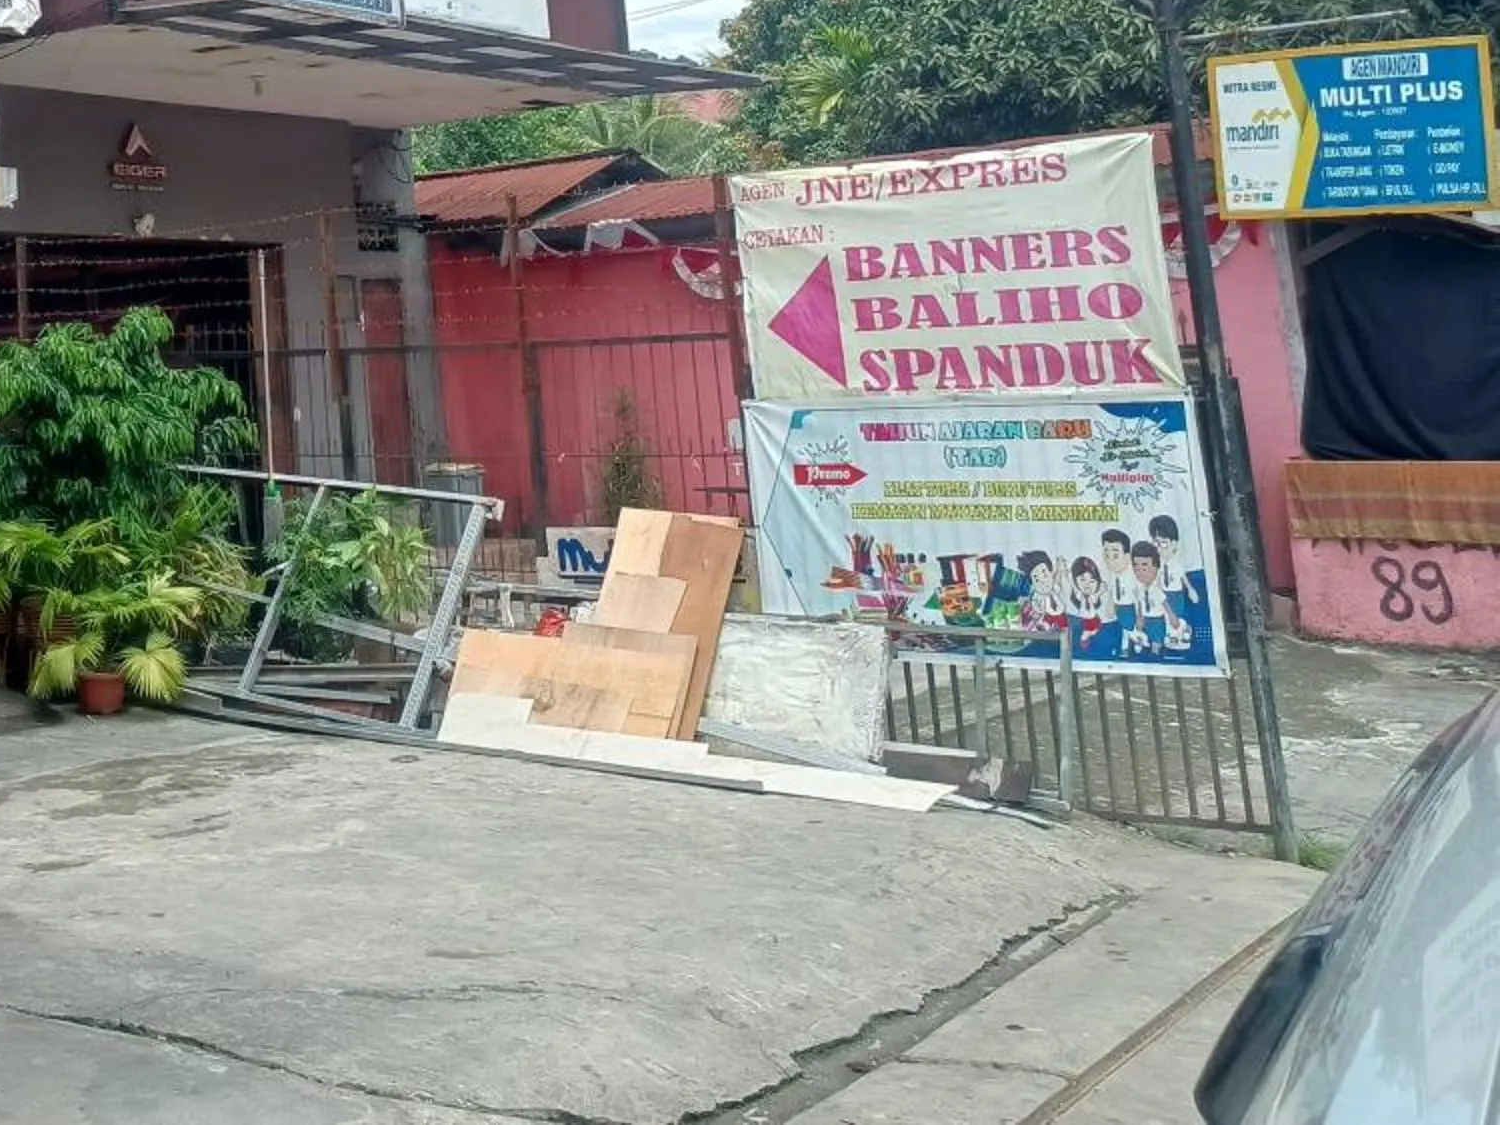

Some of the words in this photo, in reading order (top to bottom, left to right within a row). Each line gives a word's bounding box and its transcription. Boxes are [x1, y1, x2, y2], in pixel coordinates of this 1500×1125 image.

[1319, 84, 1393, 108] MULTI
[1400, 80, 1464, 104] PLUS
[1226, 119, 1280, 142] mandiri
[740, 180, 786, 202] AGEN
[795, 152, 1067, 206] JNE/EXPRES
[843, 225, 1134, 282] BANNERS
[851, 282, 1144, 332] BALIHO
[858, 338, 1164, 395] SPANDUK
[557, 537, 614, 573] Mu
[1371, 556, 1453, 625] 89
